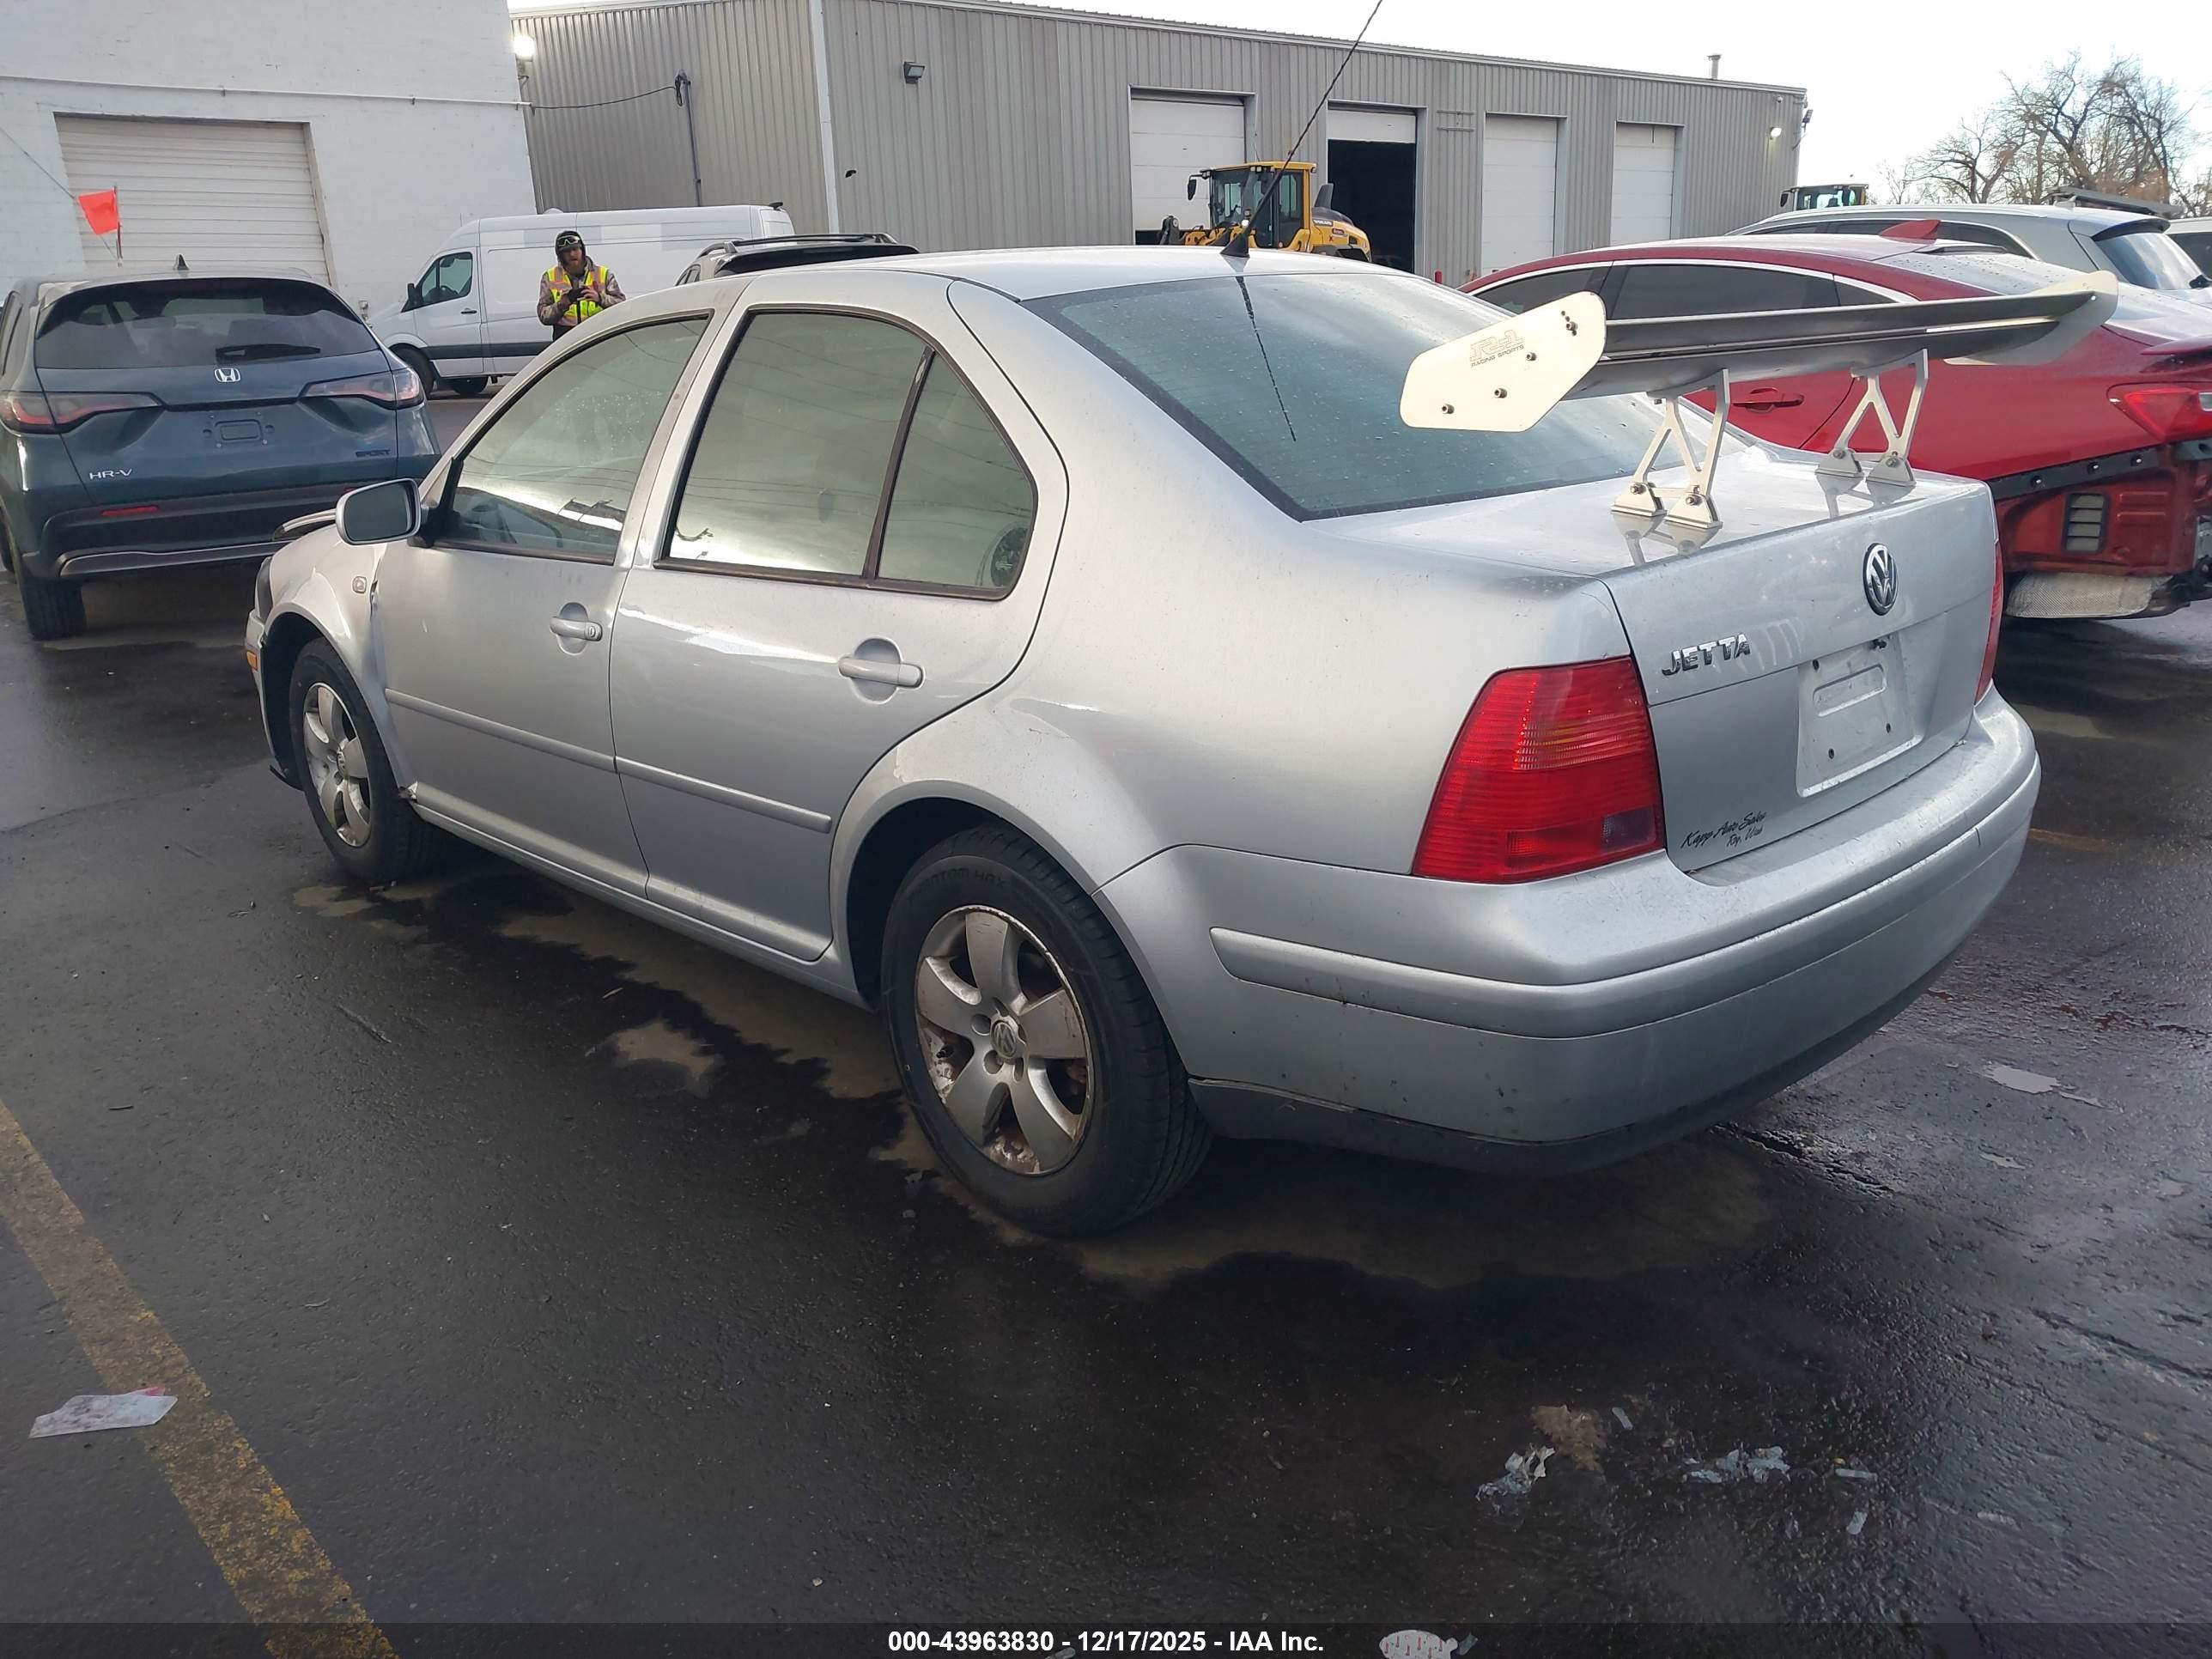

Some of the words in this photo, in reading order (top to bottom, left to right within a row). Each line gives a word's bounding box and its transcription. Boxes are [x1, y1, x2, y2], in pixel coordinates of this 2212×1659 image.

[1471, 356, 1496, 368] RACING
[1498, 344, 1524, 358] SPORTS
[88, 468, 133, 482] HR-V
[1662, 631, 1752, 677] JETTA
[1712, 821, 1739, 839] Auto
[1739, 811, 1766, 830] Sales
